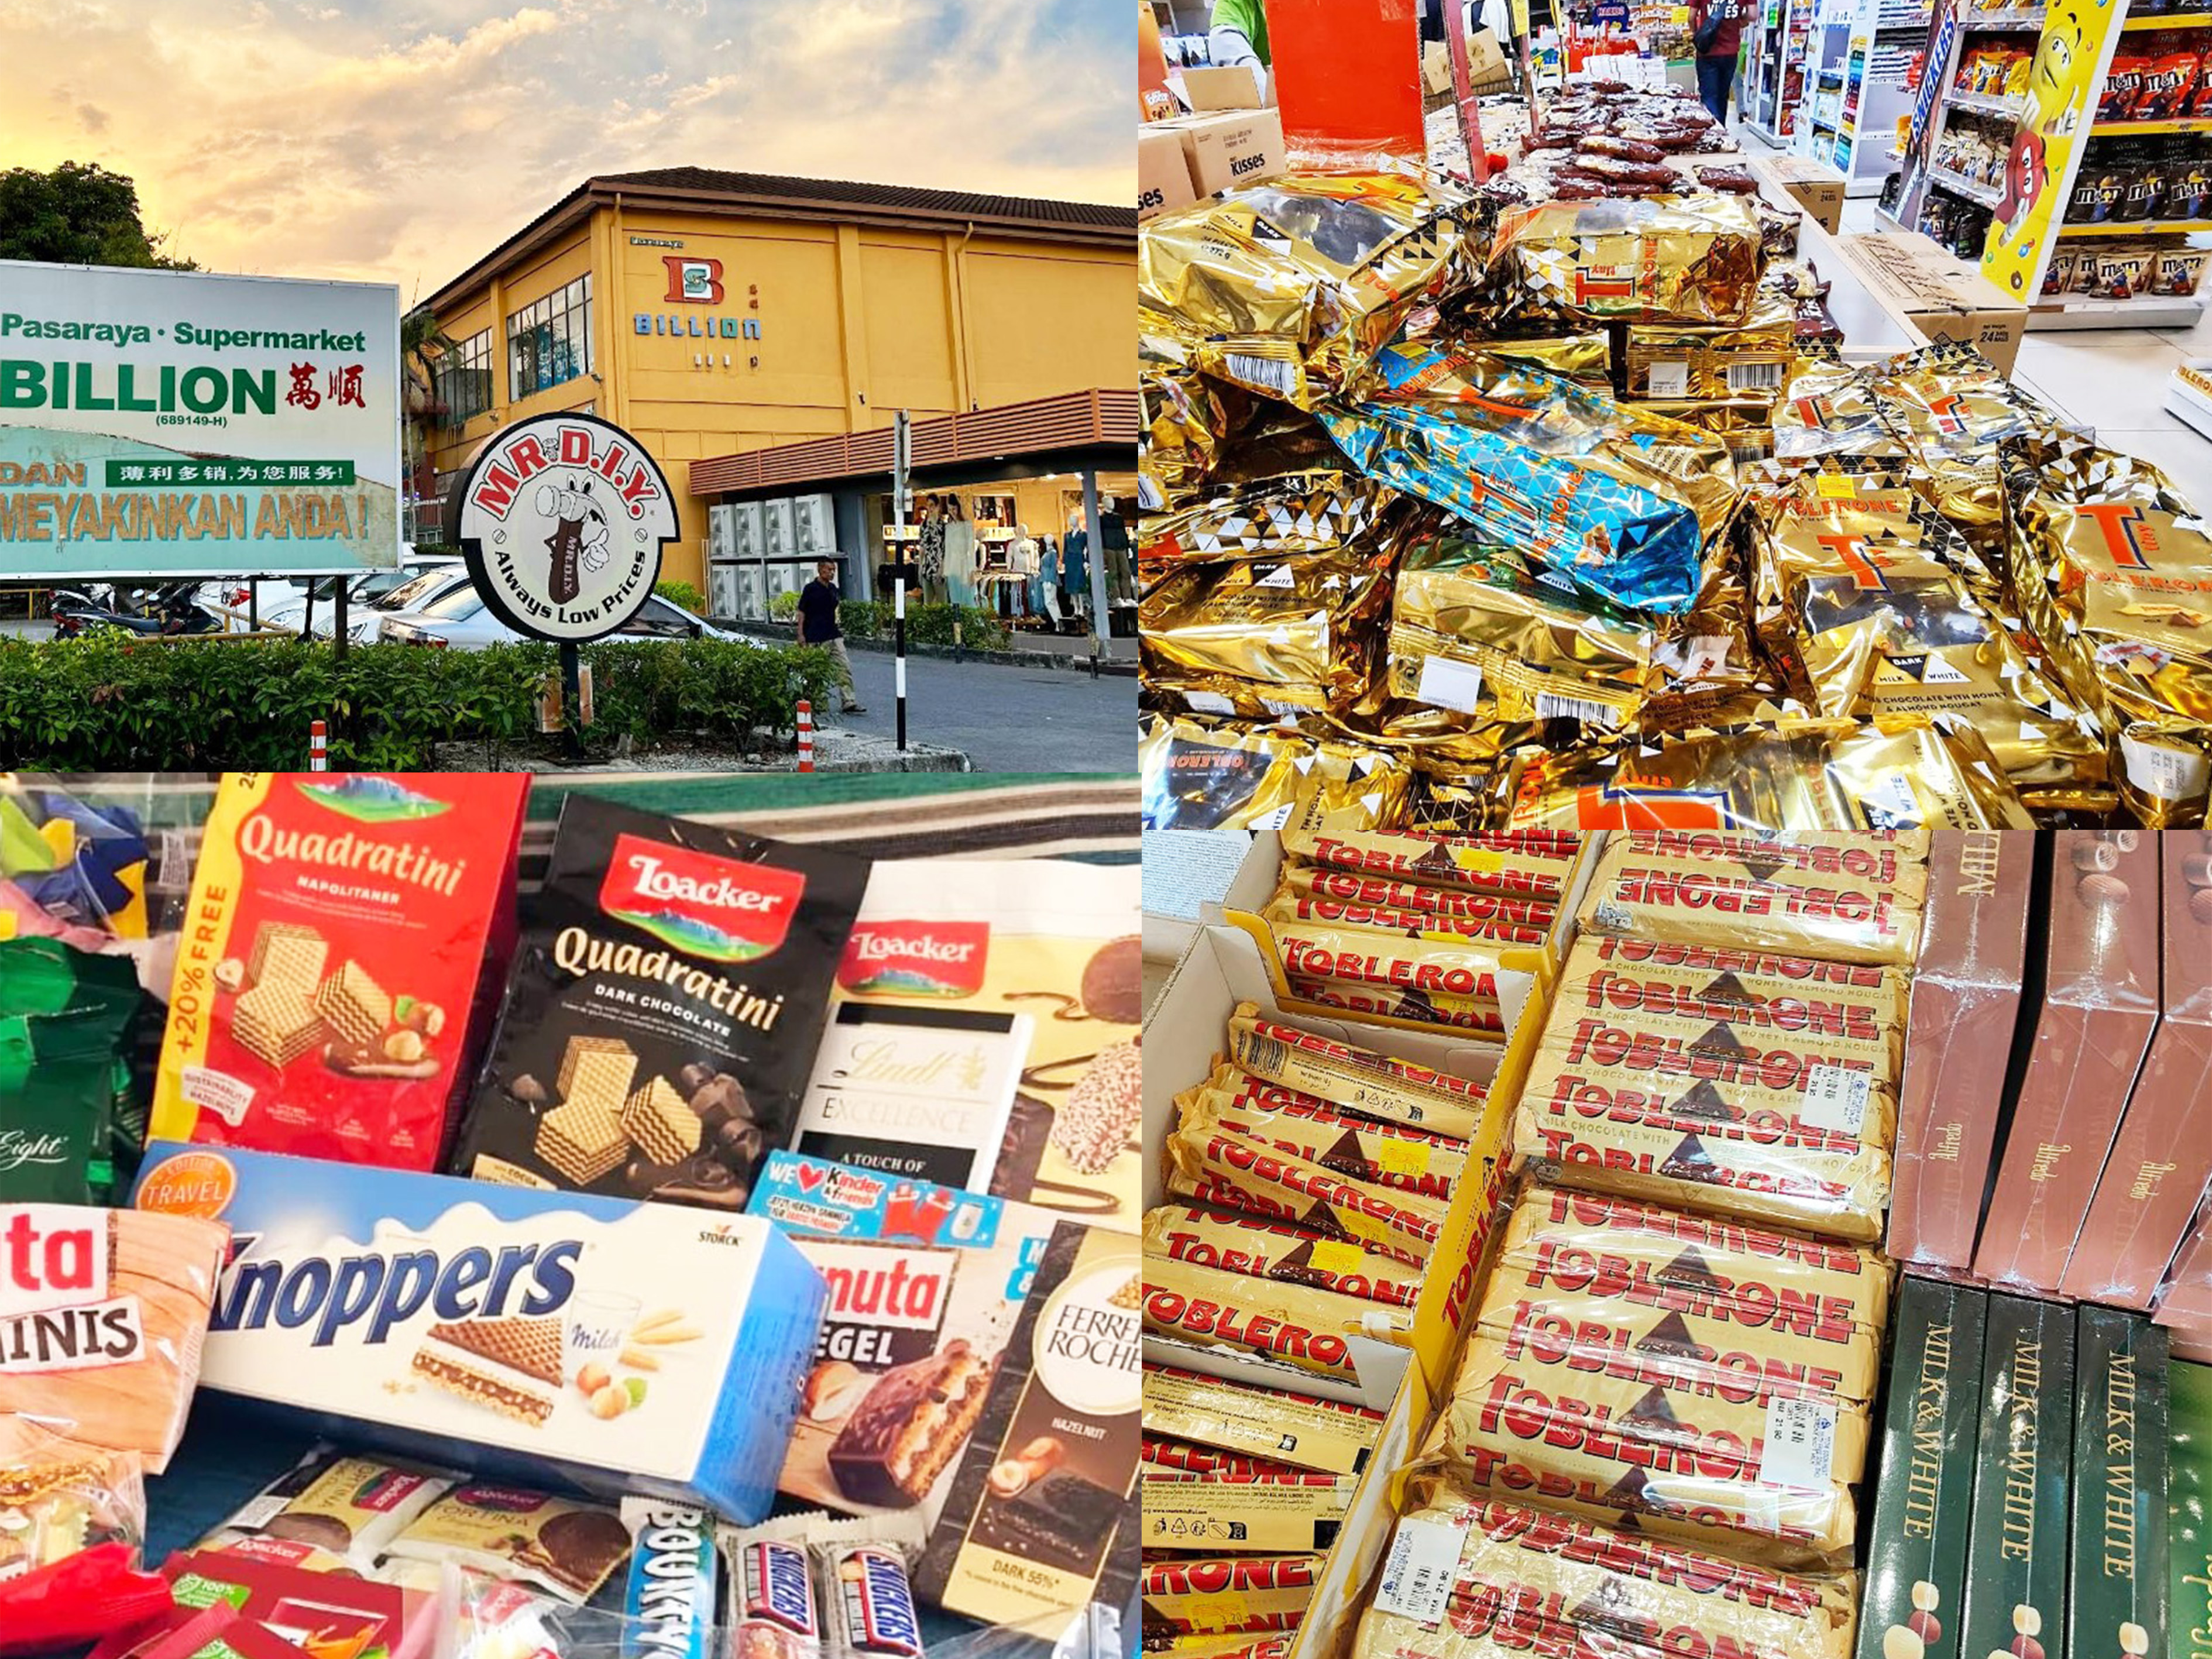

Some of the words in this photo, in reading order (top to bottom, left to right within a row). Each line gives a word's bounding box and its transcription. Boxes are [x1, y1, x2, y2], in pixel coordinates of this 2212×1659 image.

[1912, 12, 1956, 144] SNICKERS
[1, 313, 150, 348] Pasaraya
[174, 322, 366, 352] Supermarket
[0, 359, 276, 415] BILLION
[156, 415, 228, 428] (689149-H)
[494, 550, 552, 619] Always
[558, 606, 599, 624] Low
[602, 550, 646, 614] Prices
[1892, 657, 1924, 667] DARK
[1883, 695, 1945, 704] CHOCOLATE
[1946, 693, 1970, 702] WITH
[1971, 691, 2008, 700] HONEY
[1896, 704, 1938, 712] ALMOND
[240, 814, 468, 898] Quadratini
[296, 874, 401, 905] NAPOLITANER
[629, 854, 783, 913] Loacker
[1310, 868, 1558, 926] TOBLERONE
[190, 883, 227, 963] FREE
[850, 930, 976, 964] Loacker
[554, 926, 785, 1032] Quadratini
[174, 966, 207, 1053] +20%
[593, 983, 637, 1006] DARK
[639, 994, 732, 1039] CHOCOLATE
[1585, 968, 1881, 1042] TOBLERONE
[850, 1038, 959, 1091] Lindt
[822, 1096, 974, 1135] EXCELLENCE
[1571, 1121, 1641, 1143] CHOCOLATE
[1642, 1132, 1672, 1146] WITH
[0, 1130, 70, 1168] Eight
[1928, 1120, 1963, 1162] Alfredo
[768, 1162, 795, 1186] WE
[825, 1166, 884, 1196] Kinder
[840, 1153, 850, 1166] A
[851, 1154, 901, 1171] TOUCH
[904, 1160, 926, 1173] OF
[2029, 1142, 2072, 1182] Alfredo
[2128, 1160, 2177, 1201] Alfredo
[147, 1179, 224, 1205] TRAVEL
[832, 1189, 877, 1208] friends
[5, 1213, 94, 1291] ta
[699, 1231, 741, 1247] STORCK
[1523, 1234, 1856, 1344] TOBLERONE
[571, 1322, 623, 1350] Milch
[1141, 1282, 1355, 1371] TOBLERO
[1918, 1321, 1952, 1397] MILK
[2011, 1337, 2042, 1416] MILK
[1916, 1400, 1942, 1418] &
[2107, 1349, 2137, 1433] MILK
[1051, 1416, 1108, 1441] HAZELNUT
[2107, 1433, 2132, 1456] &
[1903, 1425, 1940, 1540] WHITE
[2001, 1450, 2037, 1563] WHITE
[2104, 1464, 2135, 1581] WHITE
[236, 1538, 303, 1560] Loacker
[991, 1557, 1025, 1579] DARK
[768, 1545, 810, 1626] SNICKERS
[1141, 1558, 1314, 1596] RONE
[866, 1554, 918, 1648] SNICKERS
